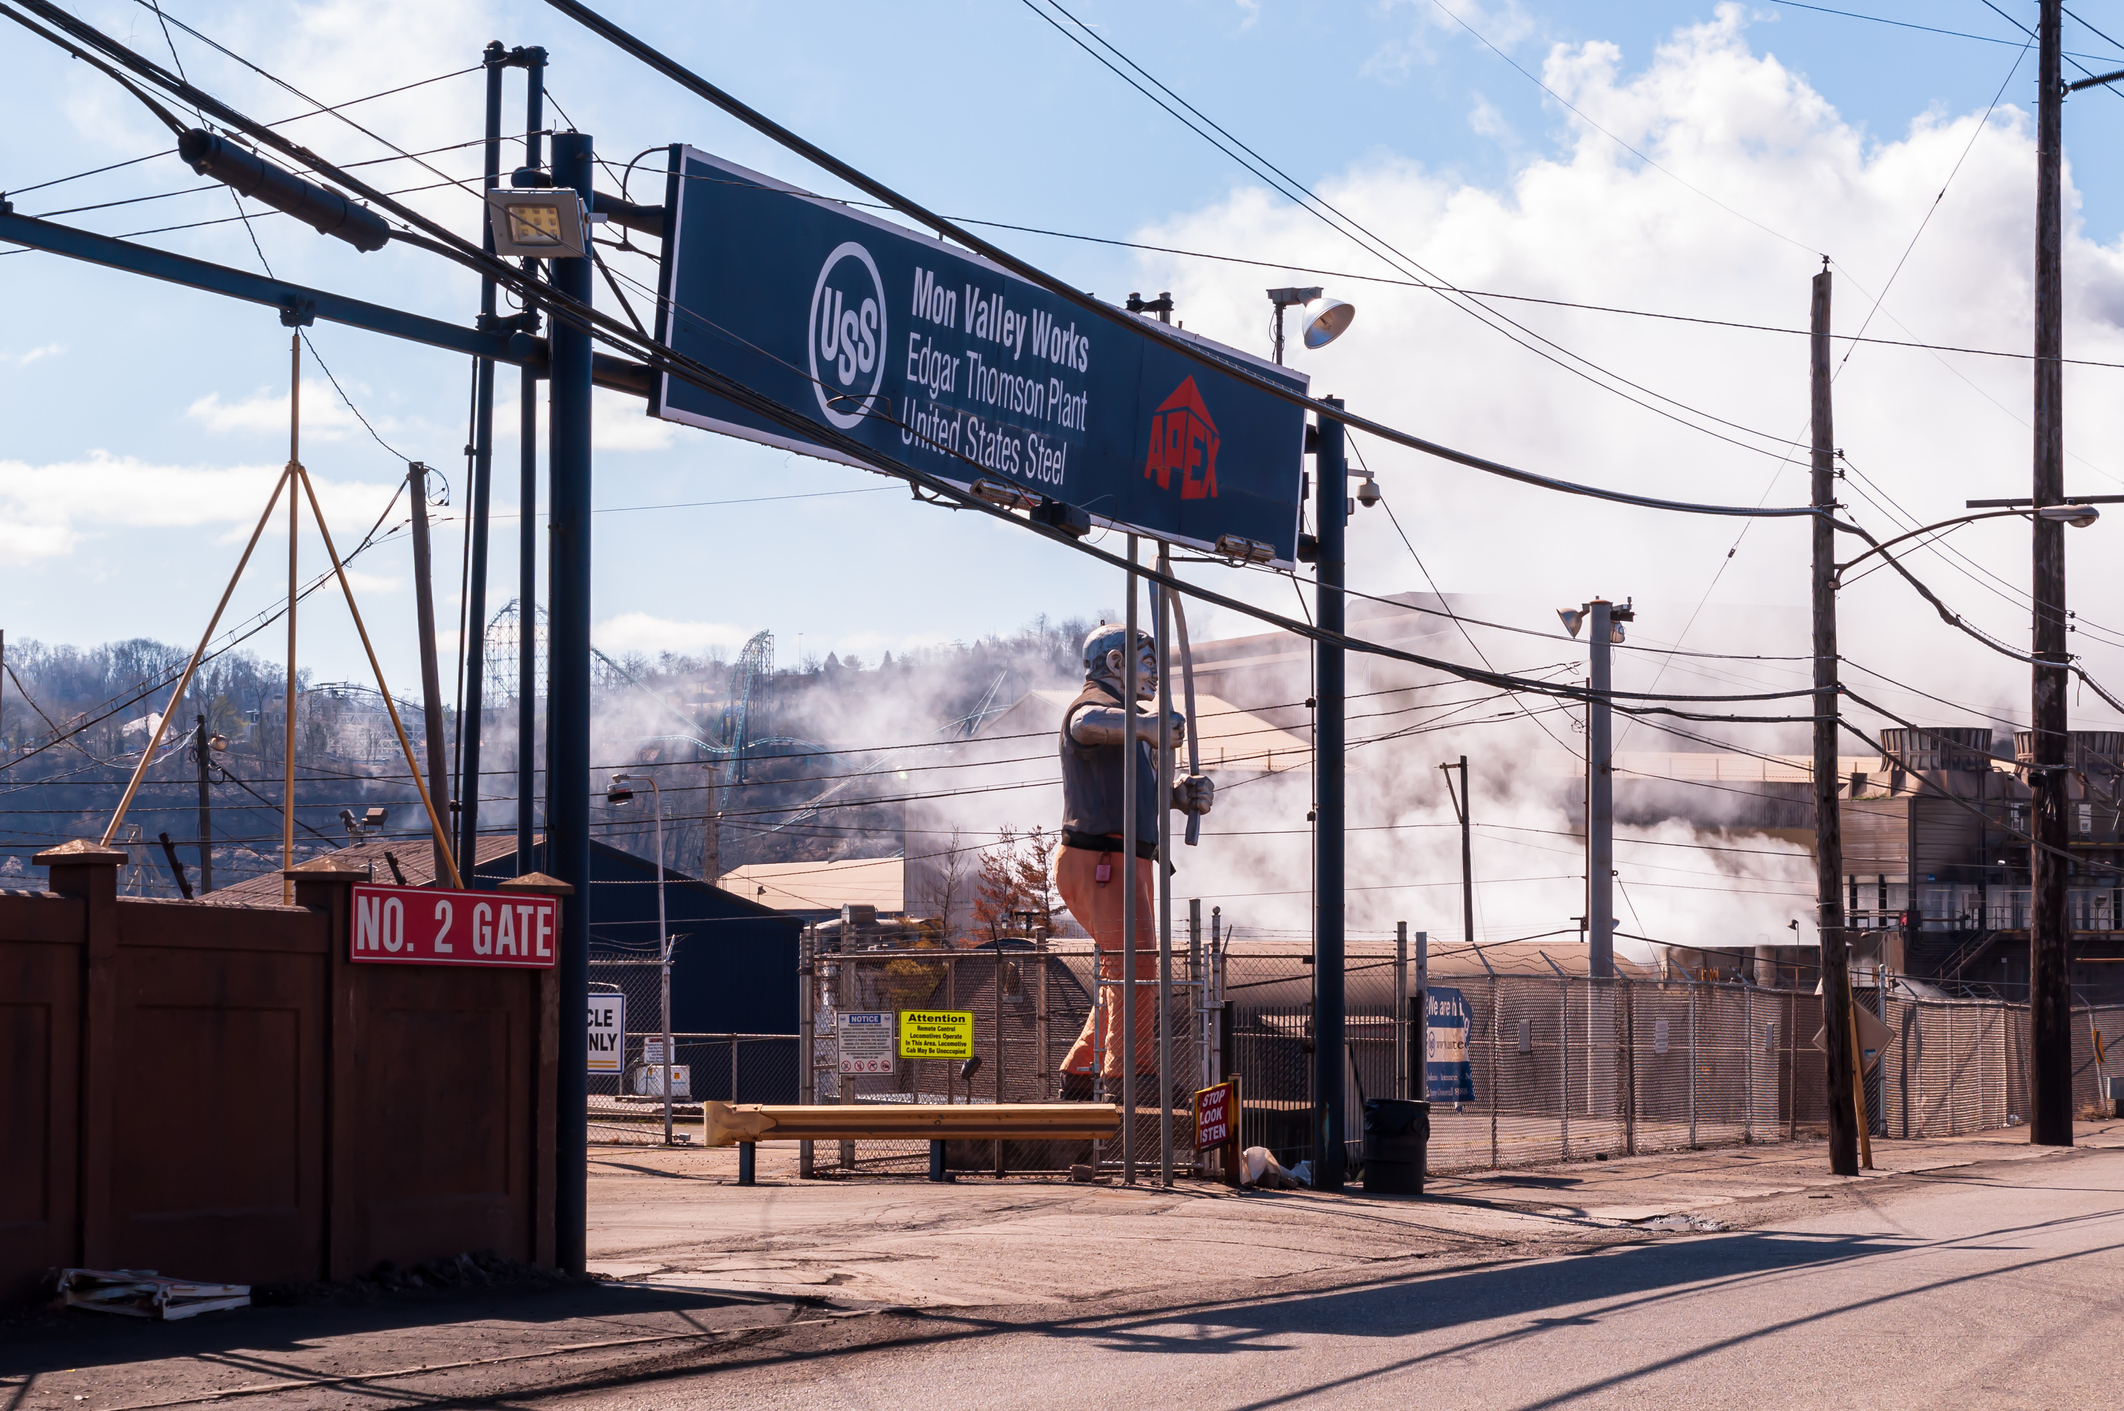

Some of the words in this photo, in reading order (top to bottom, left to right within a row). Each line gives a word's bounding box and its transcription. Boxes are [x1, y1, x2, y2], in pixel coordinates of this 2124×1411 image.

[912, 266, 957, 329] Mon
[965, 284, 1027, 361] Valley
[1032, 308, 1089, 373] Works
[821, 286, 878, 386] USS
[907, 332, 960, 399] Edgar
[966, 350, 1044, 419] Thomson
[1047, 377, 1088, 431] Plant
[901, 397, 961, 458] United
[965, 416, 1021, 474] States
[1025, 433, 1067, 485] Steel
[1144, 410, 1221, 500] APEX
[357, 895, 415, 953] NO.
[434, 899, 453, 953] 2
[472, 902, 552, 957] GATE
[1428, 995, 1439, 1016] We
[1439, 1000, 1451, 1016] are
[587, 1009, 613, 1027] CLE
[851, 1015, 879, 1023] NOTICE
[908, 1013, 966, 1023] Attention
[588, 1033, 618, 1051] NLY
[917, 1047, 928, 1055] May
[1202, 1089, 1226, 1108] STOP
[1200, 1106, 1223, 1126] LOOK
